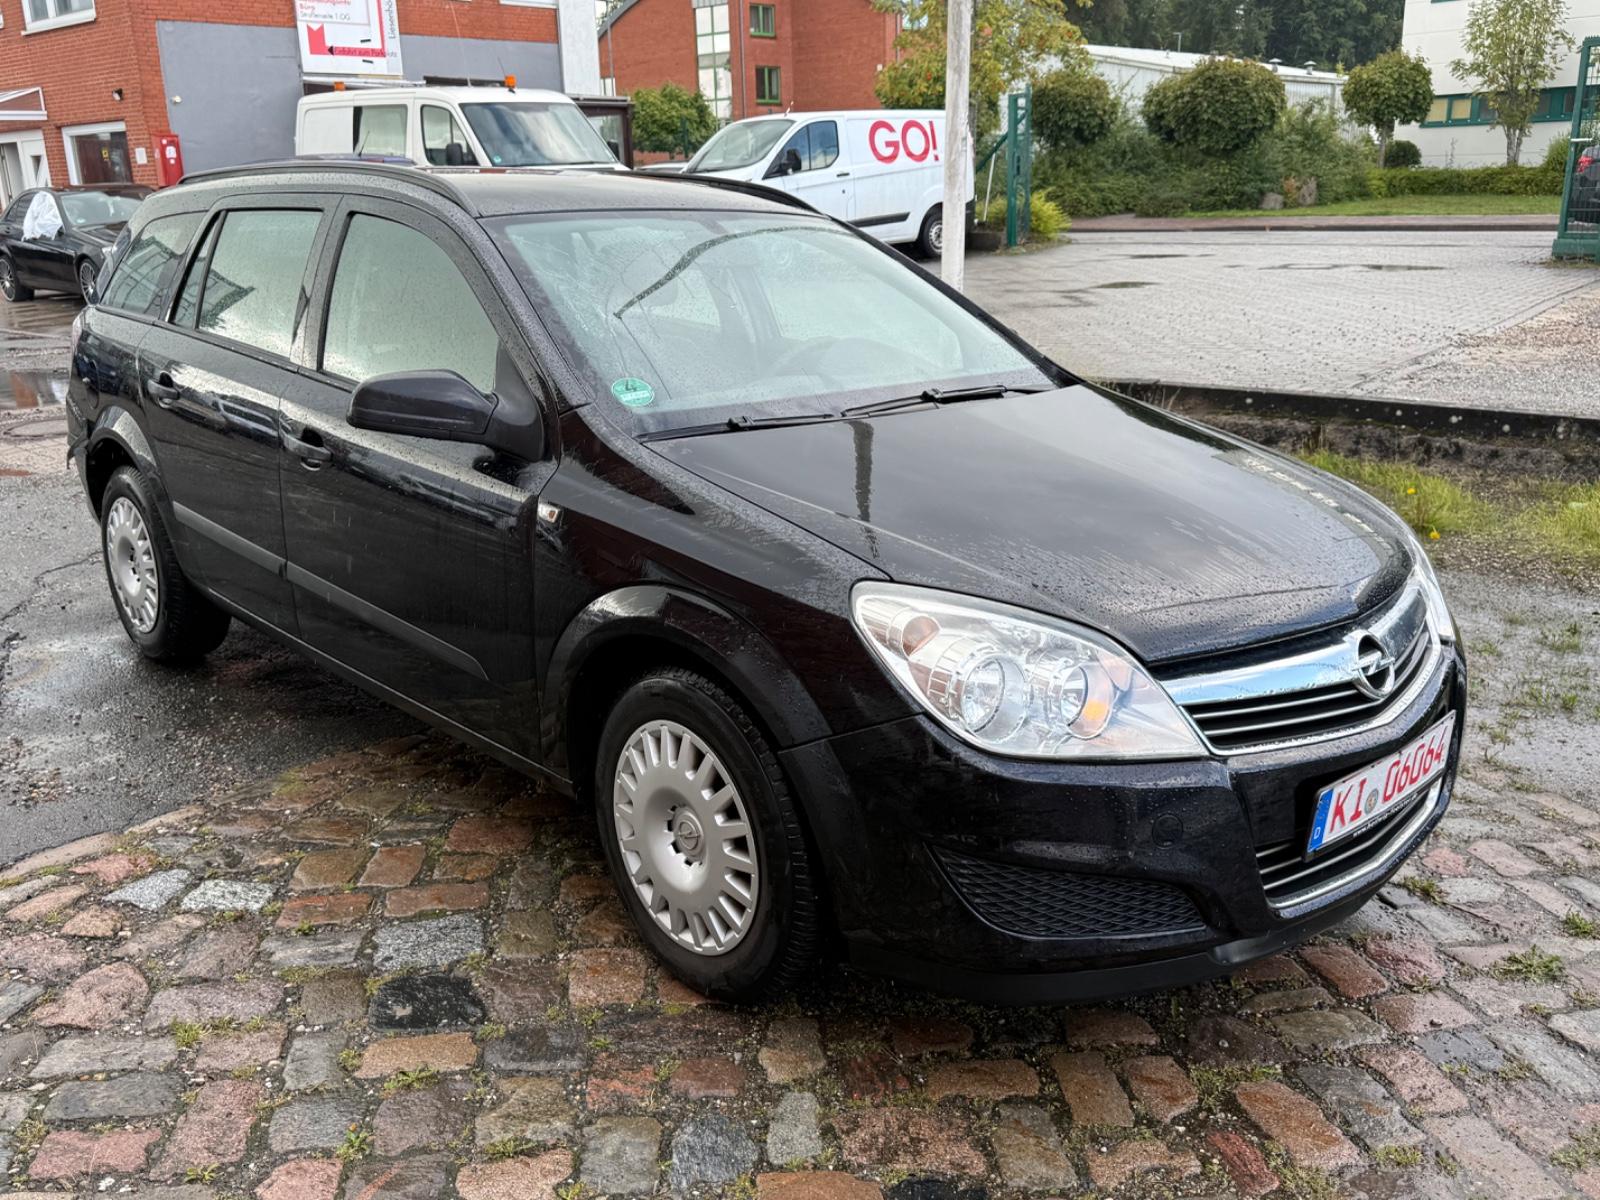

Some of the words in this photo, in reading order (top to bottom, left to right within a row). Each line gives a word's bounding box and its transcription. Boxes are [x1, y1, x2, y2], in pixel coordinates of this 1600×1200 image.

[869, 120, 939, 164] GO!
[1330, 778, 1367, 833] KI
[1382, 726, 1448, 803] 06064
[1313, 826, 1321, 840] D
